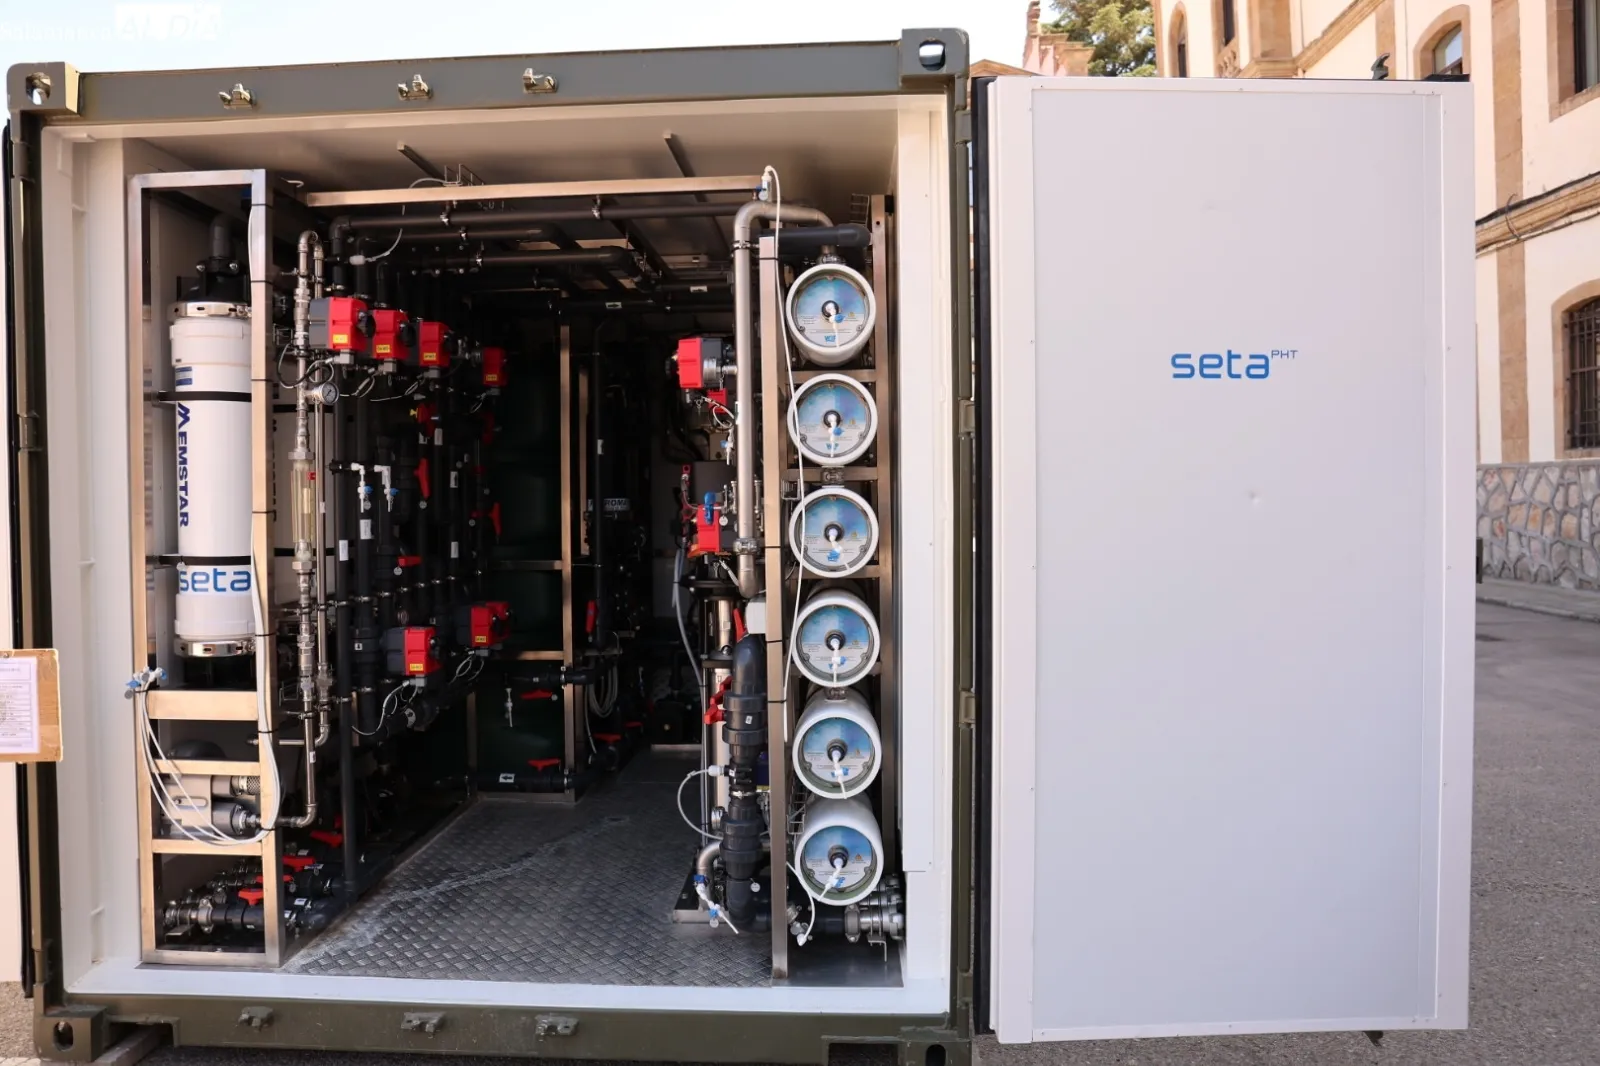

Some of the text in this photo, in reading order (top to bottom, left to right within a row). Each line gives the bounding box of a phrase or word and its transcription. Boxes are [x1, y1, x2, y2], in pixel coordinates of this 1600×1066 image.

[1171, 349, 1298, 379] seta PHT
[178, 402, 191, 527] MEMSTAR
[179, 568, 251, 592] seta
